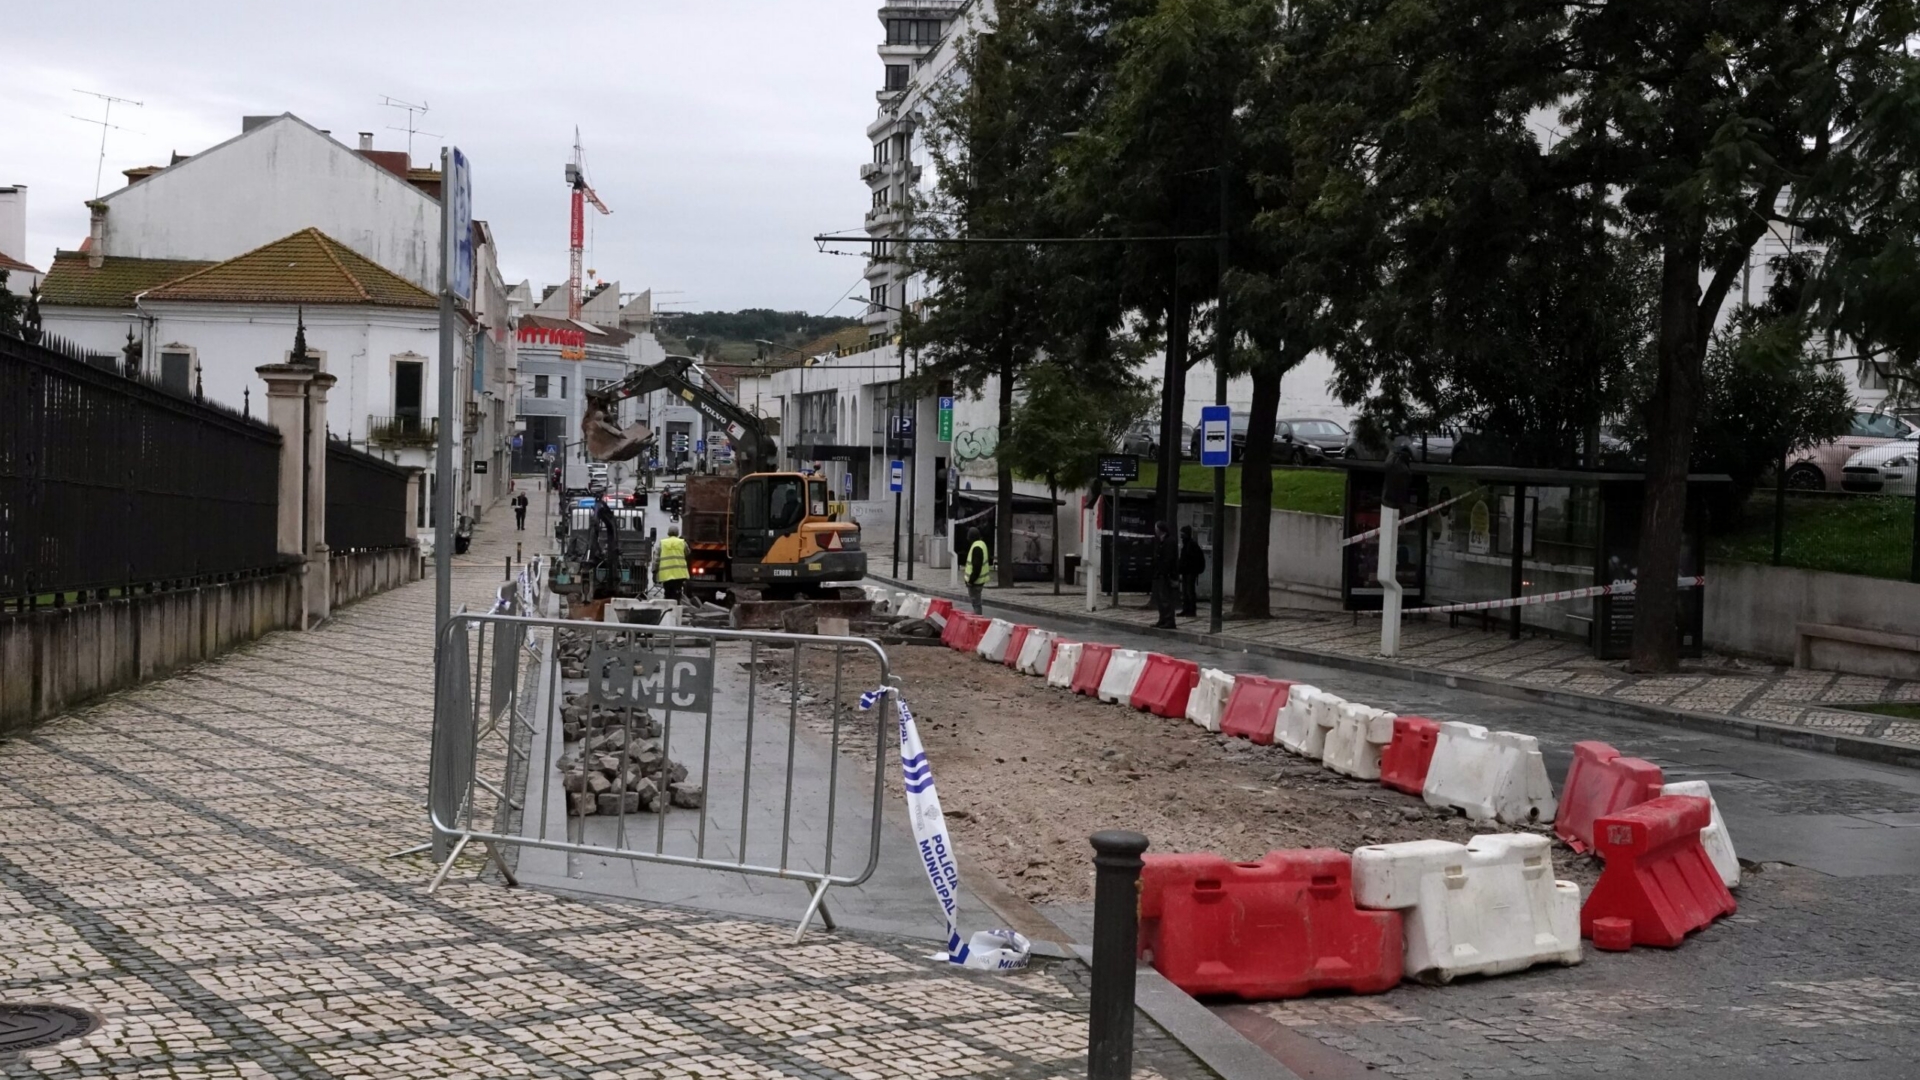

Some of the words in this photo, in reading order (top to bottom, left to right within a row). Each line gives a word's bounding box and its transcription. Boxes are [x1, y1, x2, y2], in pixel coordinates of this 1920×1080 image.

[700, 401, 727, 424] VOLVO
[600, 656, 698, 706] CMC
[919, 839, 956, 916] MUNICIPAL
[932, 834, 958, 890] POLÍCIA
